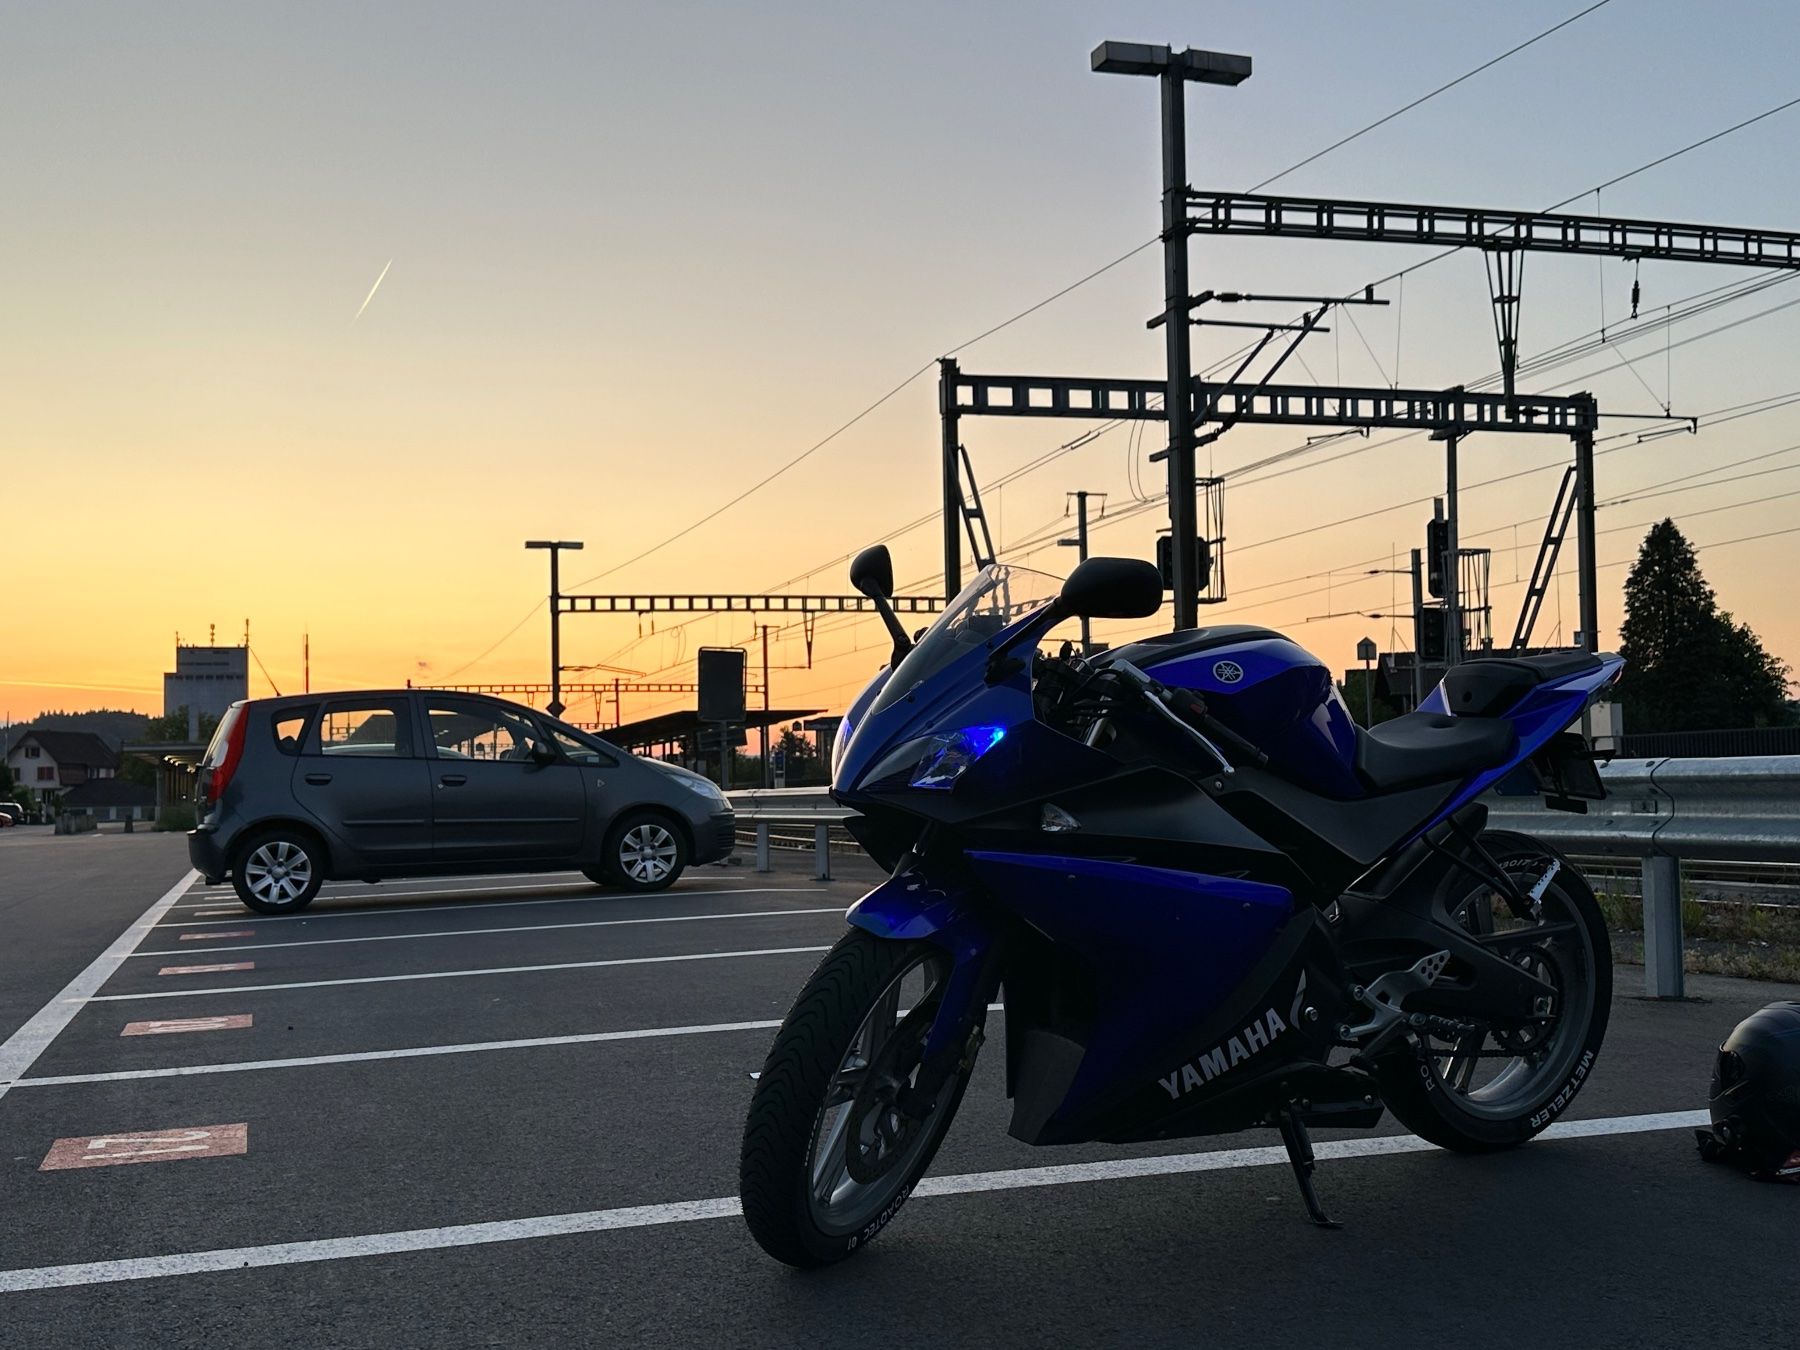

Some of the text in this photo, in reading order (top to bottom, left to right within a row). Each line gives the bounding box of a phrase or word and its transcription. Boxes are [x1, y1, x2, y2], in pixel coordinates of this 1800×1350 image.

[1157, 1006, 1287, 1100] YAMAHA
[1530, 1049, 1595, 1128] METZELER
[863, 1184, 910, 1241] ROADTEC
